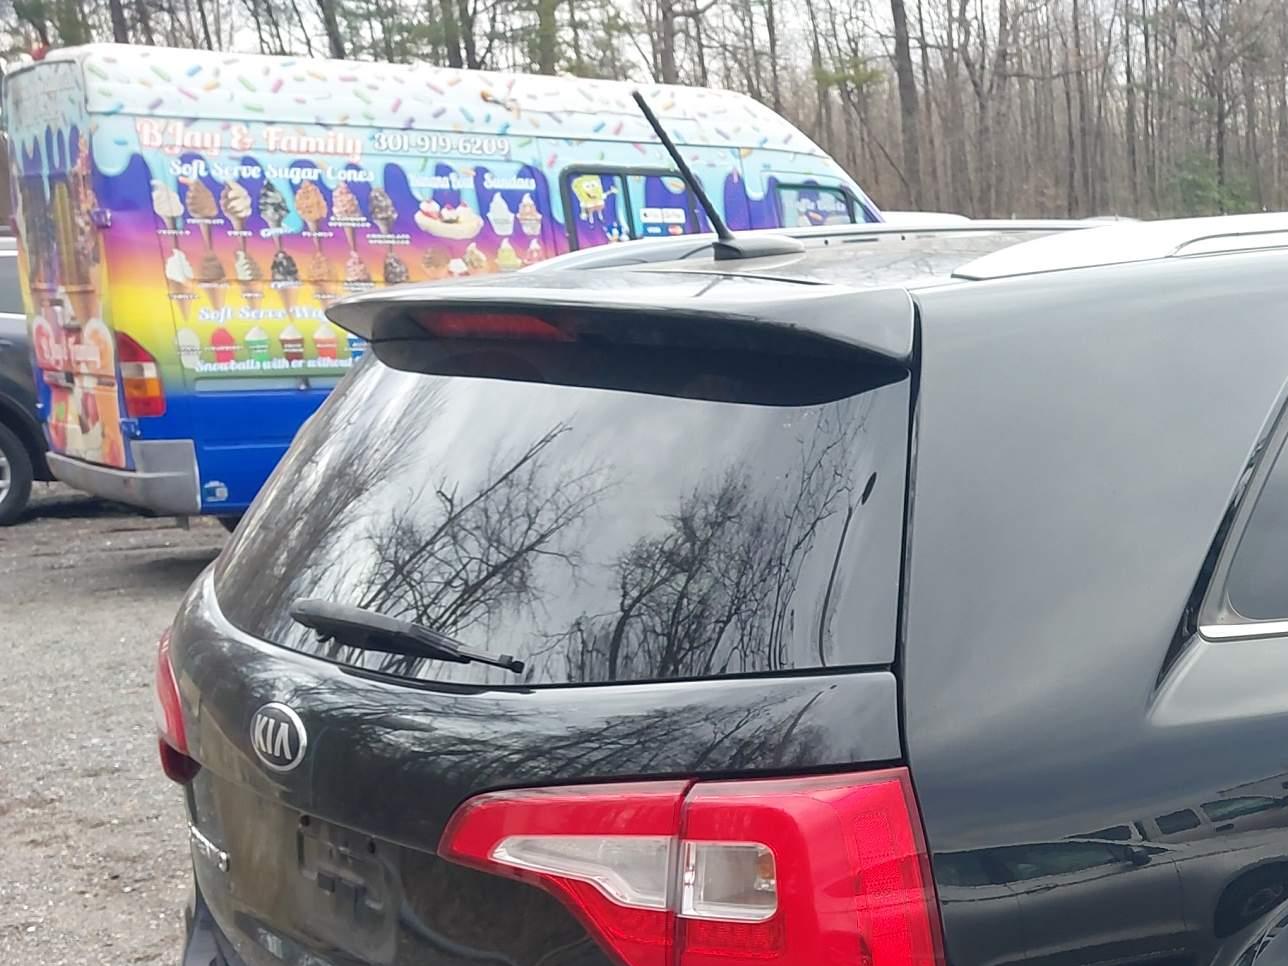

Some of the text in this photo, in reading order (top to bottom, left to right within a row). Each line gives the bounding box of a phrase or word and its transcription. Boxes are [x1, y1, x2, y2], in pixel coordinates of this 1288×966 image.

[230, 124, 255, 149] &
[263, 126, 363, 163] Family
[373, 132, 512, 156] 301-919-6209
[169, 158, 375, 184] Soft Serve Sugar Cones
[254, 713, 293, 760] KIA
